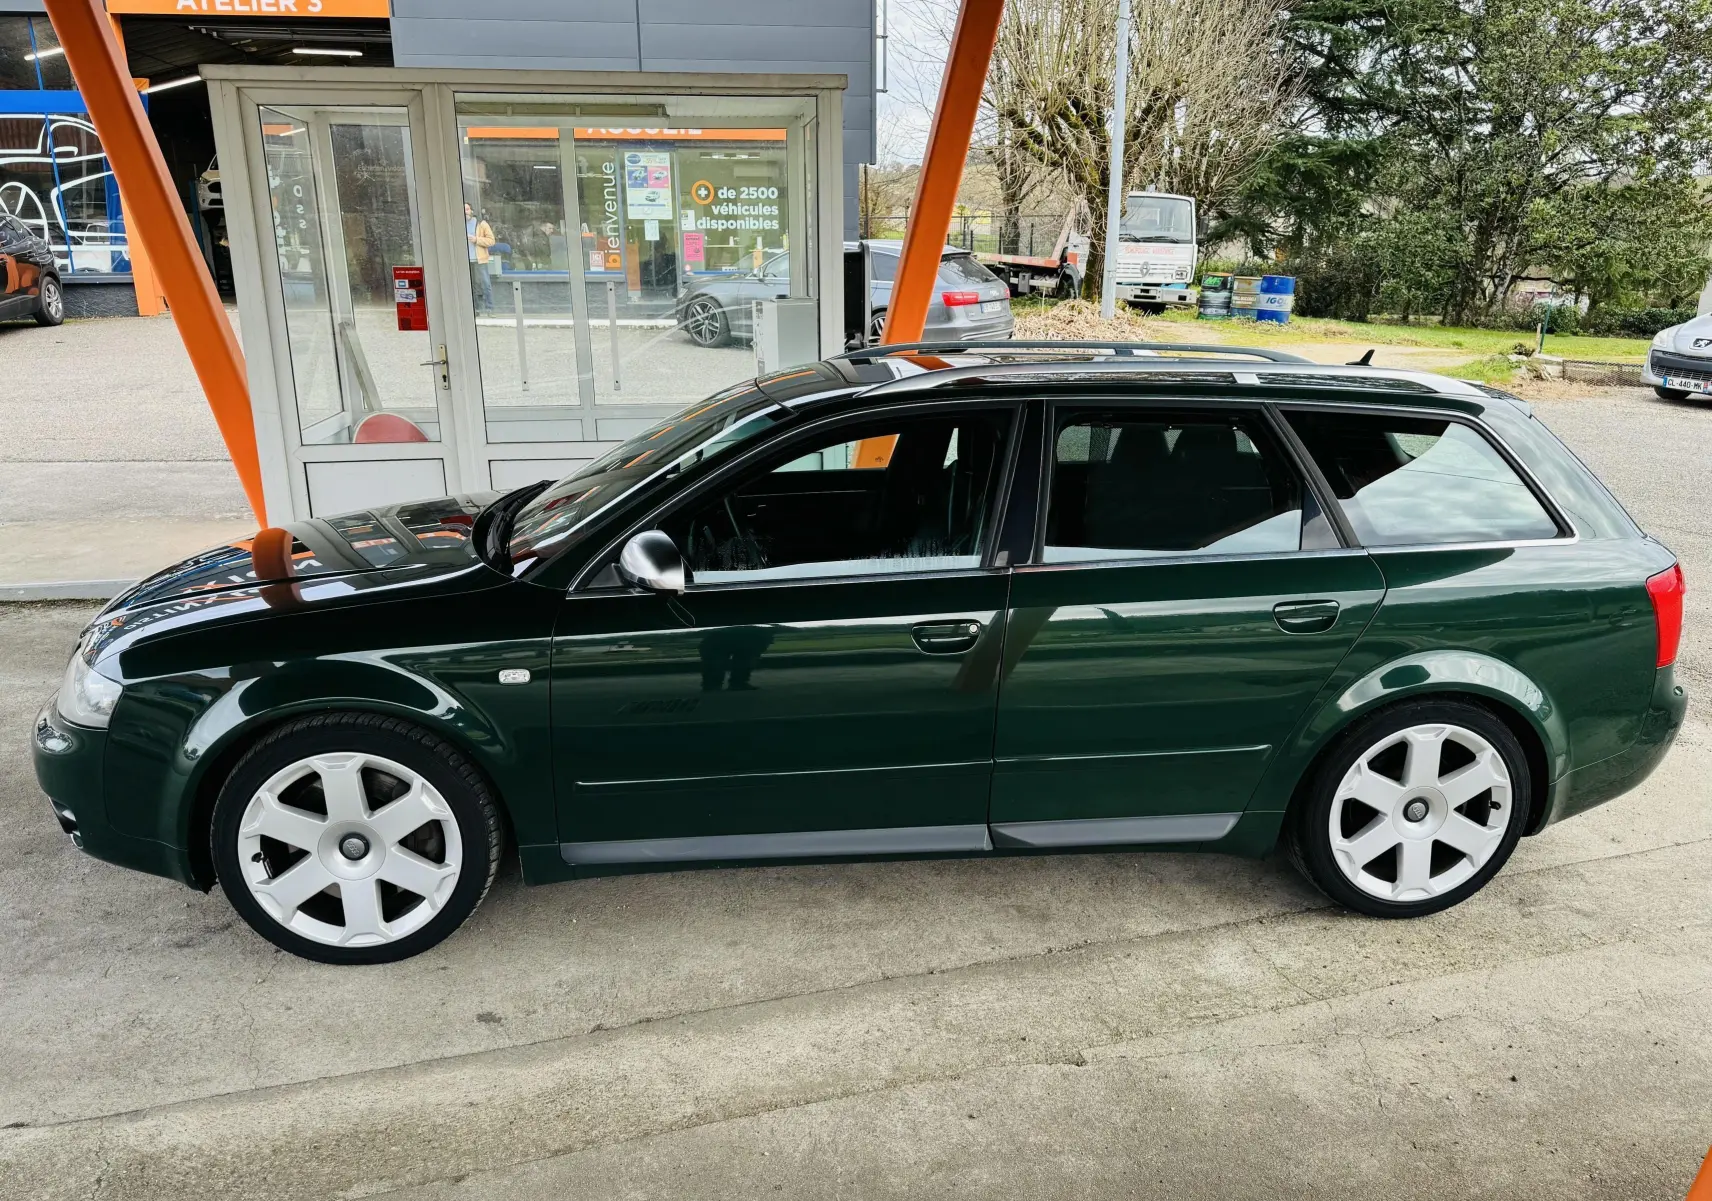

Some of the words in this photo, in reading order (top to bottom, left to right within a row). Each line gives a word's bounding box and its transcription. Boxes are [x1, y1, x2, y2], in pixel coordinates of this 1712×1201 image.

[717, 186, 737, 199] de
[739, 186, 779, 199] 2500
[602, 161, 621, 268] bienvenue
[711, 202, 779, 216] véhicules
[696, 216, 779, 232] disponibles
